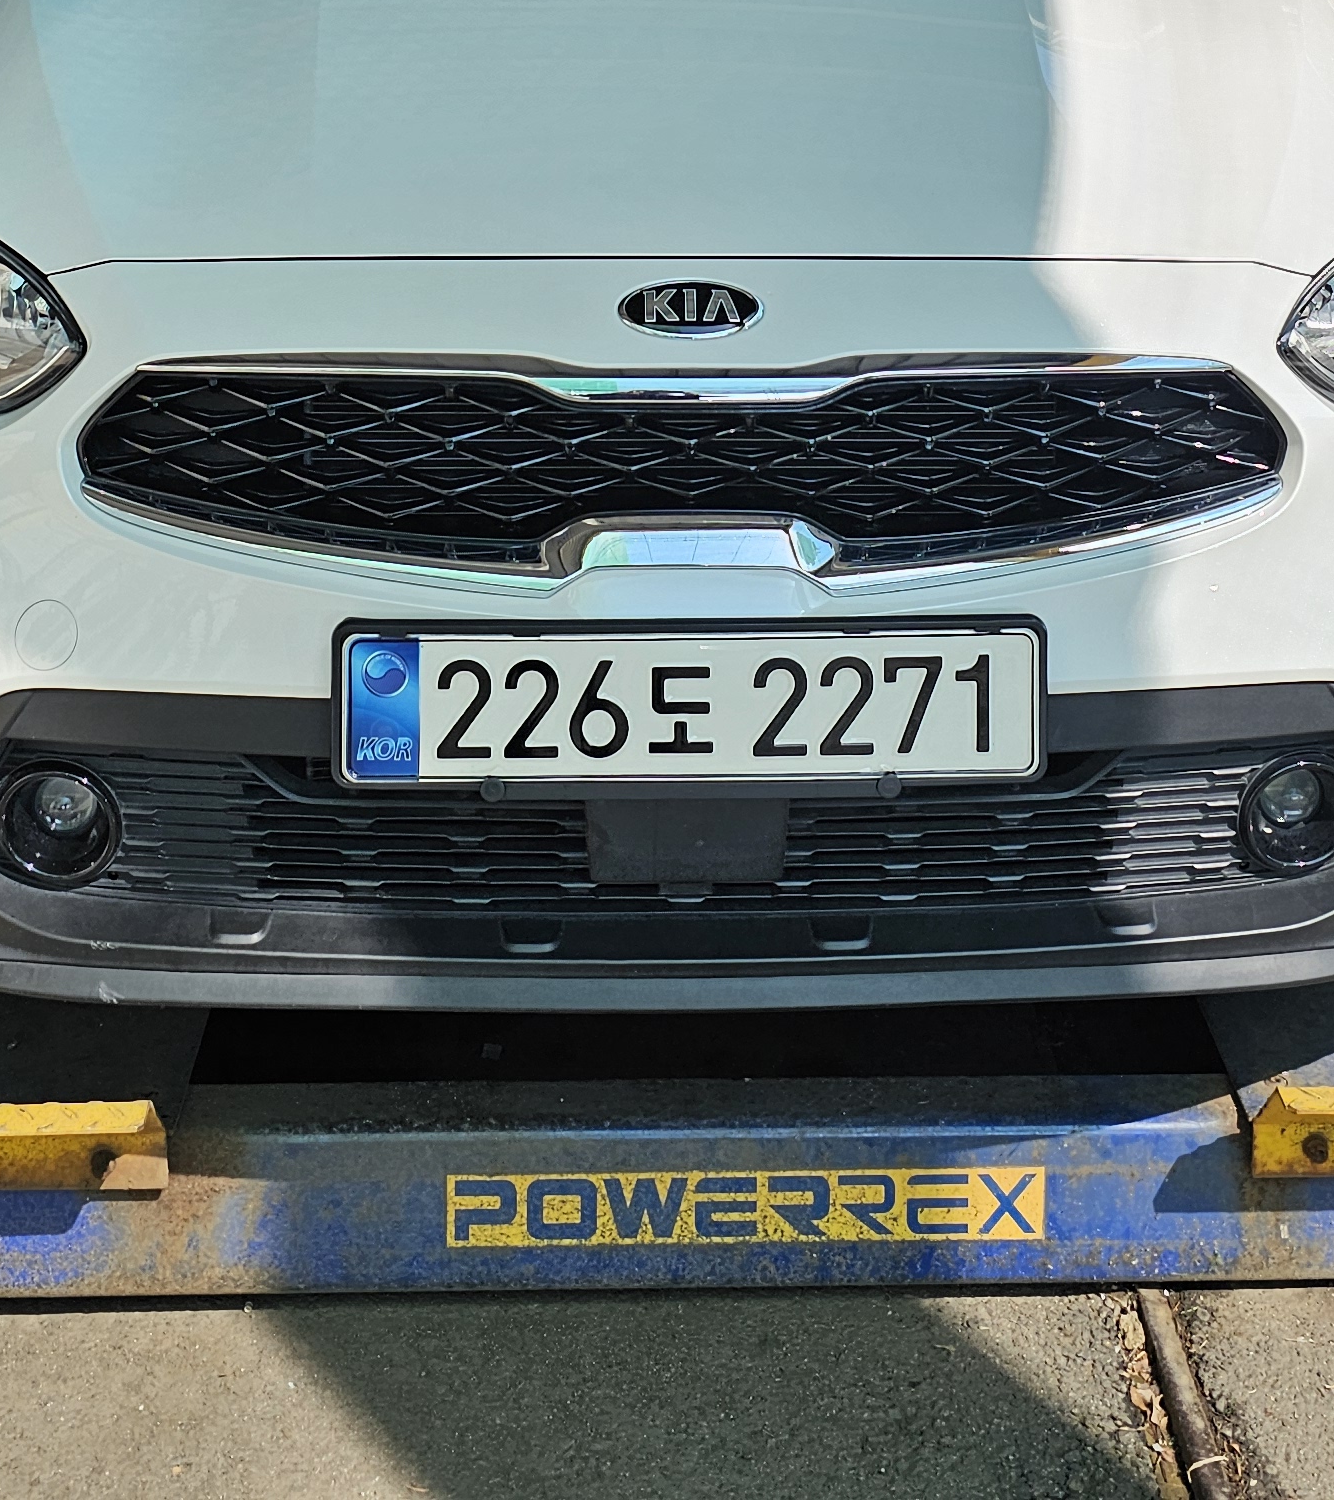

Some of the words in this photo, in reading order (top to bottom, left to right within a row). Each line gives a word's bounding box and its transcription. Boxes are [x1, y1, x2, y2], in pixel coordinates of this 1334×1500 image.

[643, 288, 741, 323] KIA
[436, 658, 714, 760] 226도
[752, 654, 990, 757] 2271
[356, 736, 413, 762] KOR
[453, 1173, 1038, 1242] POWERREX
